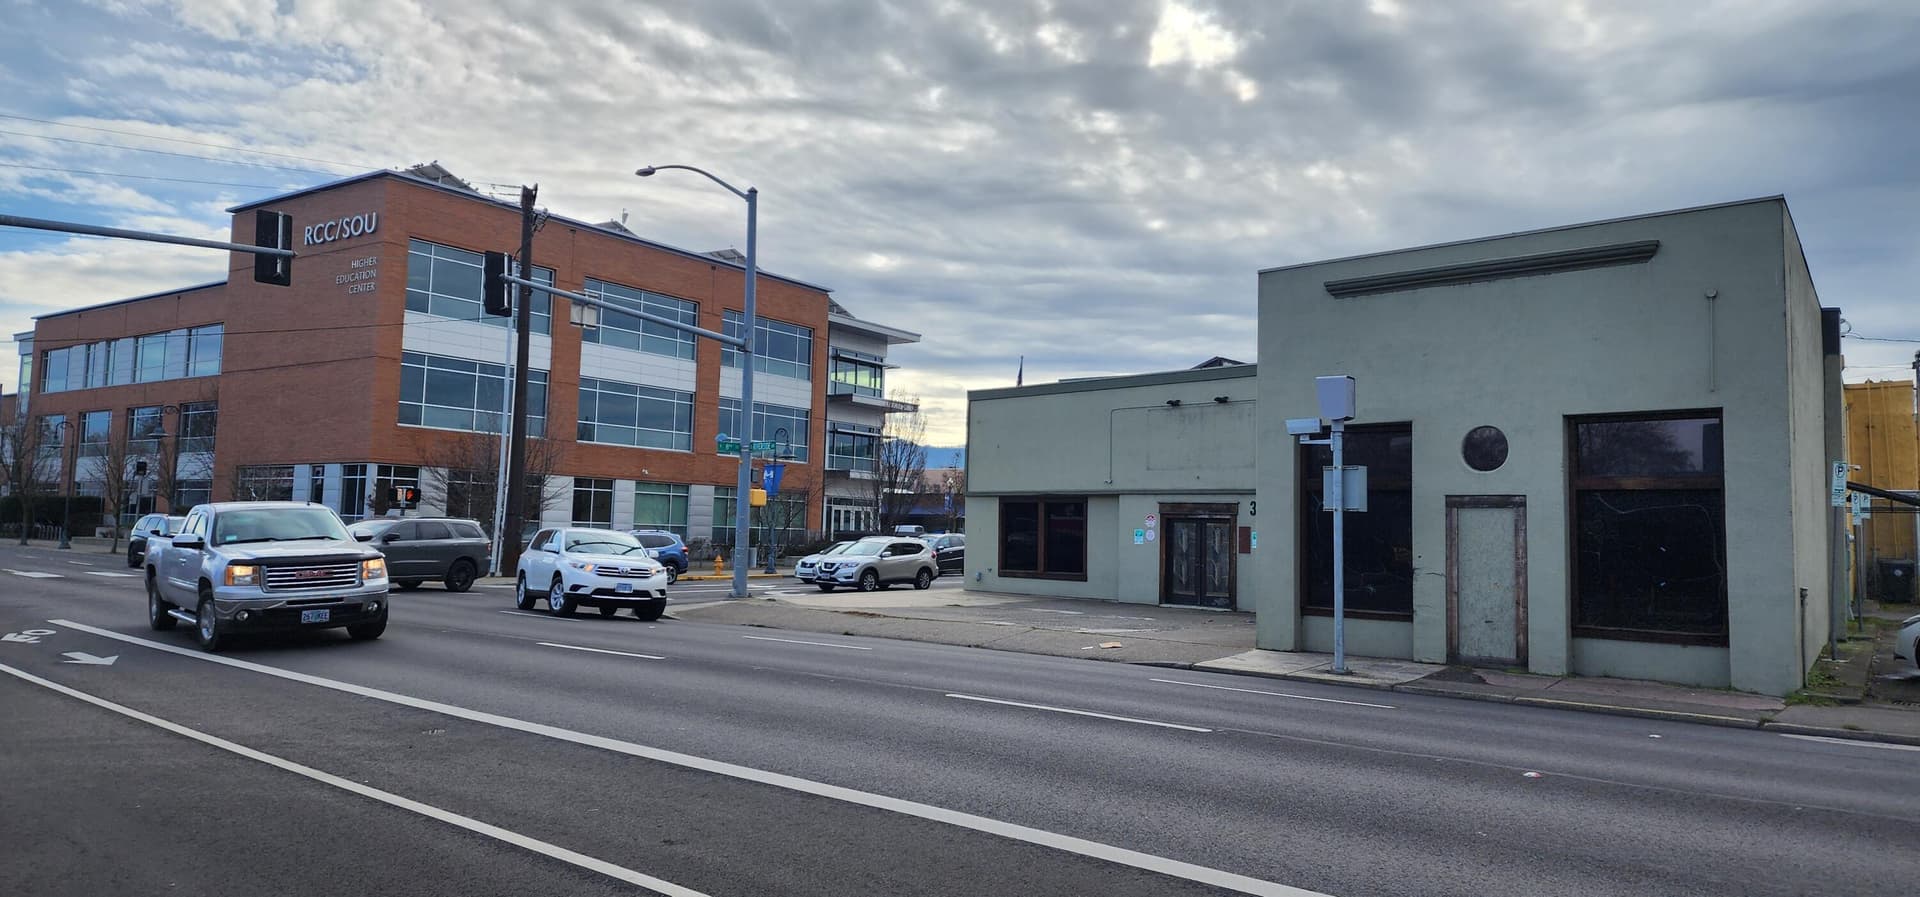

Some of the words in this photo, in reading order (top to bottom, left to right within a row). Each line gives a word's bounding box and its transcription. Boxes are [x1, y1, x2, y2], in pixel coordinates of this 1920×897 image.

[304, 211, 377, 246] RCC/SOU
[351, 256, 377, 269] HIGHER
[336, 269, 377, 285] EDUCATION
[348, 282, 376, 294] CENTER
